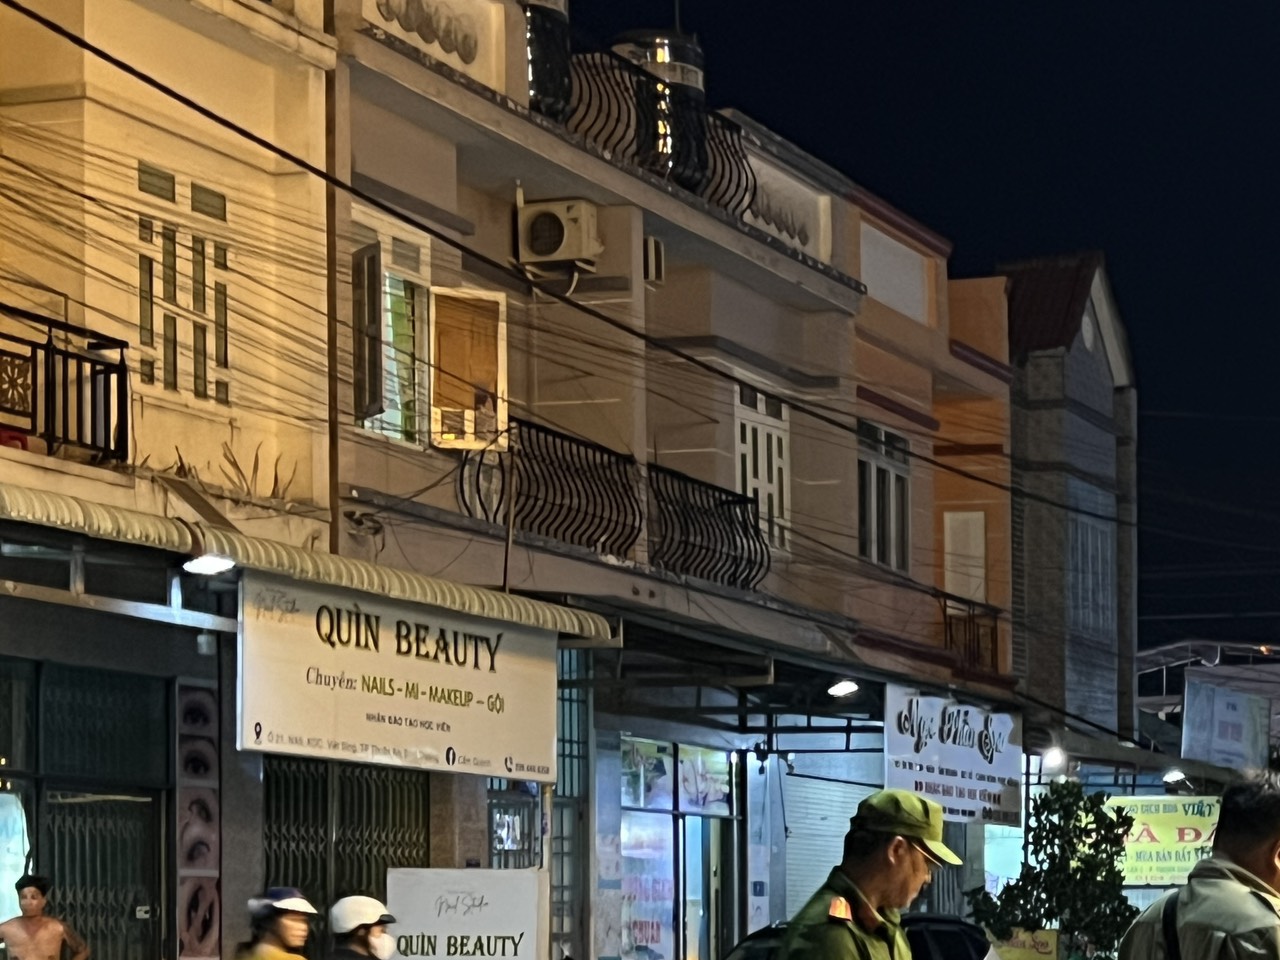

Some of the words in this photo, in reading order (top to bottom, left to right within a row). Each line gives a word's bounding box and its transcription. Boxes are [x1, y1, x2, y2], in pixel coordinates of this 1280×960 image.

[396, 620, 503, 673] BEAUTY
[362, 675, 394, 697] NAILS
[446, 932, 524, 957] BEAUTY
